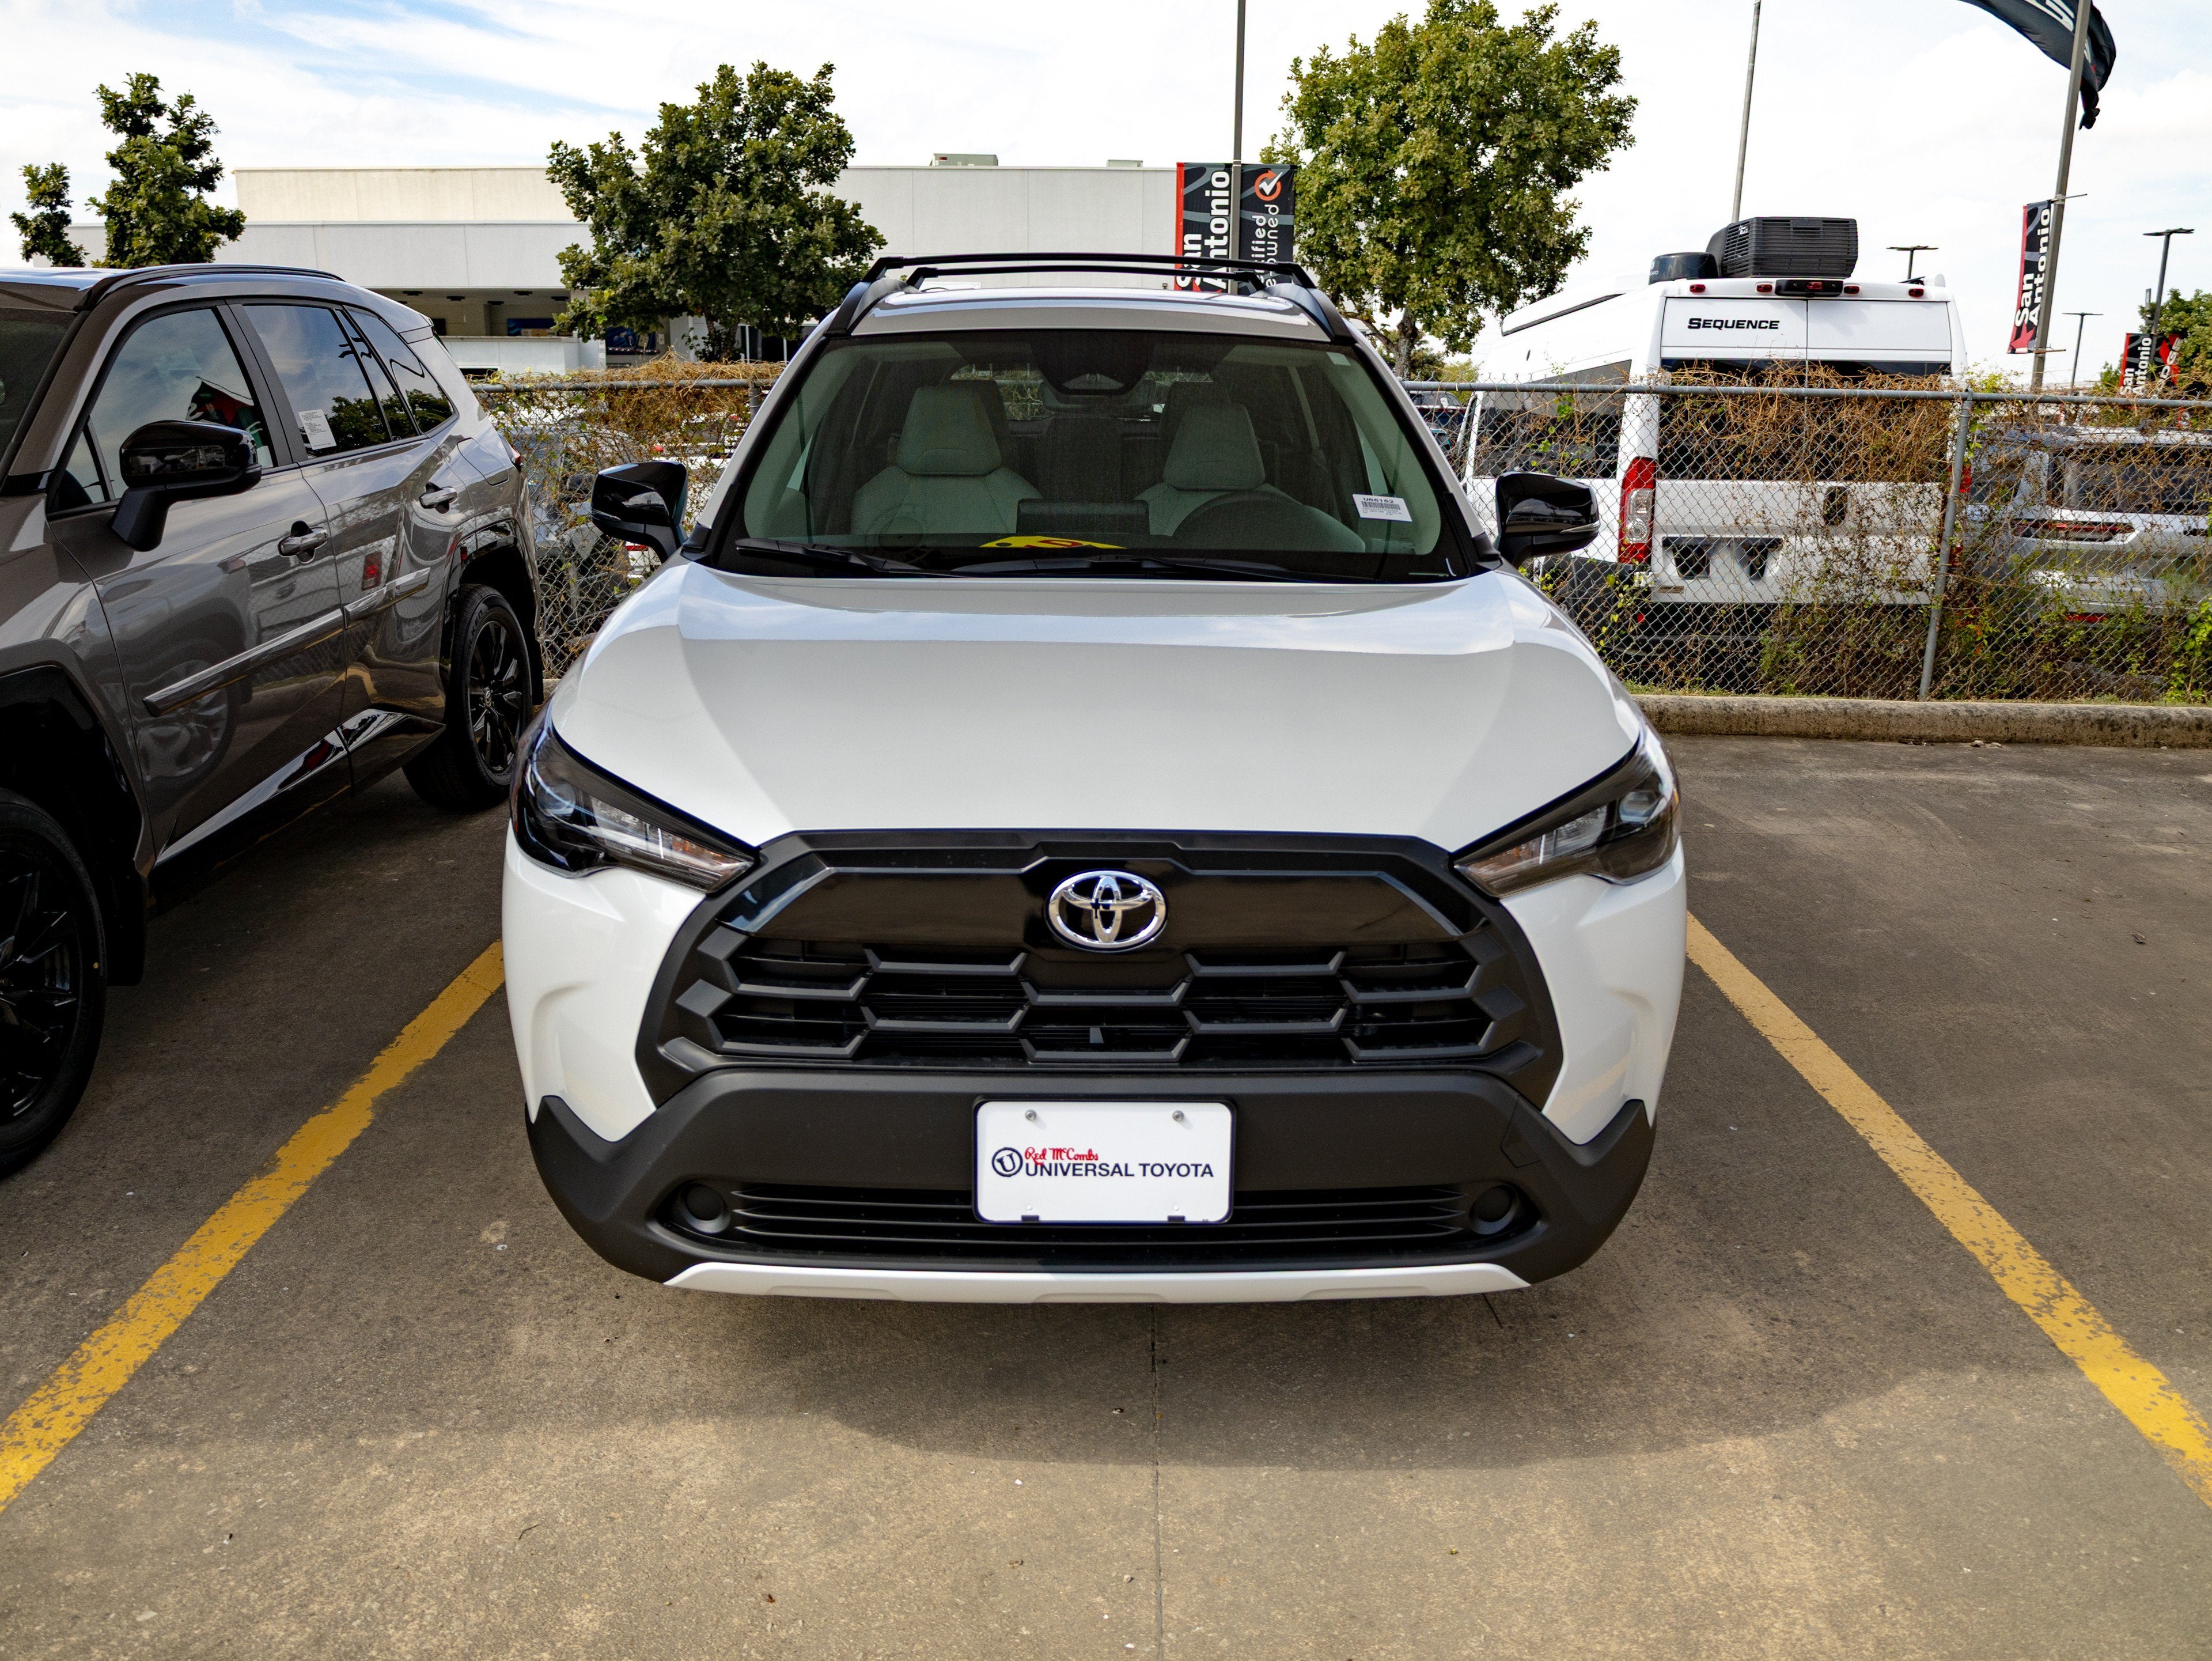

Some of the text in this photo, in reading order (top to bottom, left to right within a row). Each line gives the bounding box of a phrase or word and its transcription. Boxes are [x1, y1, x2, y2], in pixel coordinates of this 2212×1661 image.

[1203, 171, 1230, 289] Antonio
[2028, 208, 2050, 327] Antonio
[2015, 273, 2035, 327] San
[1687, 317, 1780, 330] SEQUENCE
[1024, 1147, 1099, 1166] Red McCombs
[1025, 1162, 1214, 1178] UNIVERSAL TOYOTA
